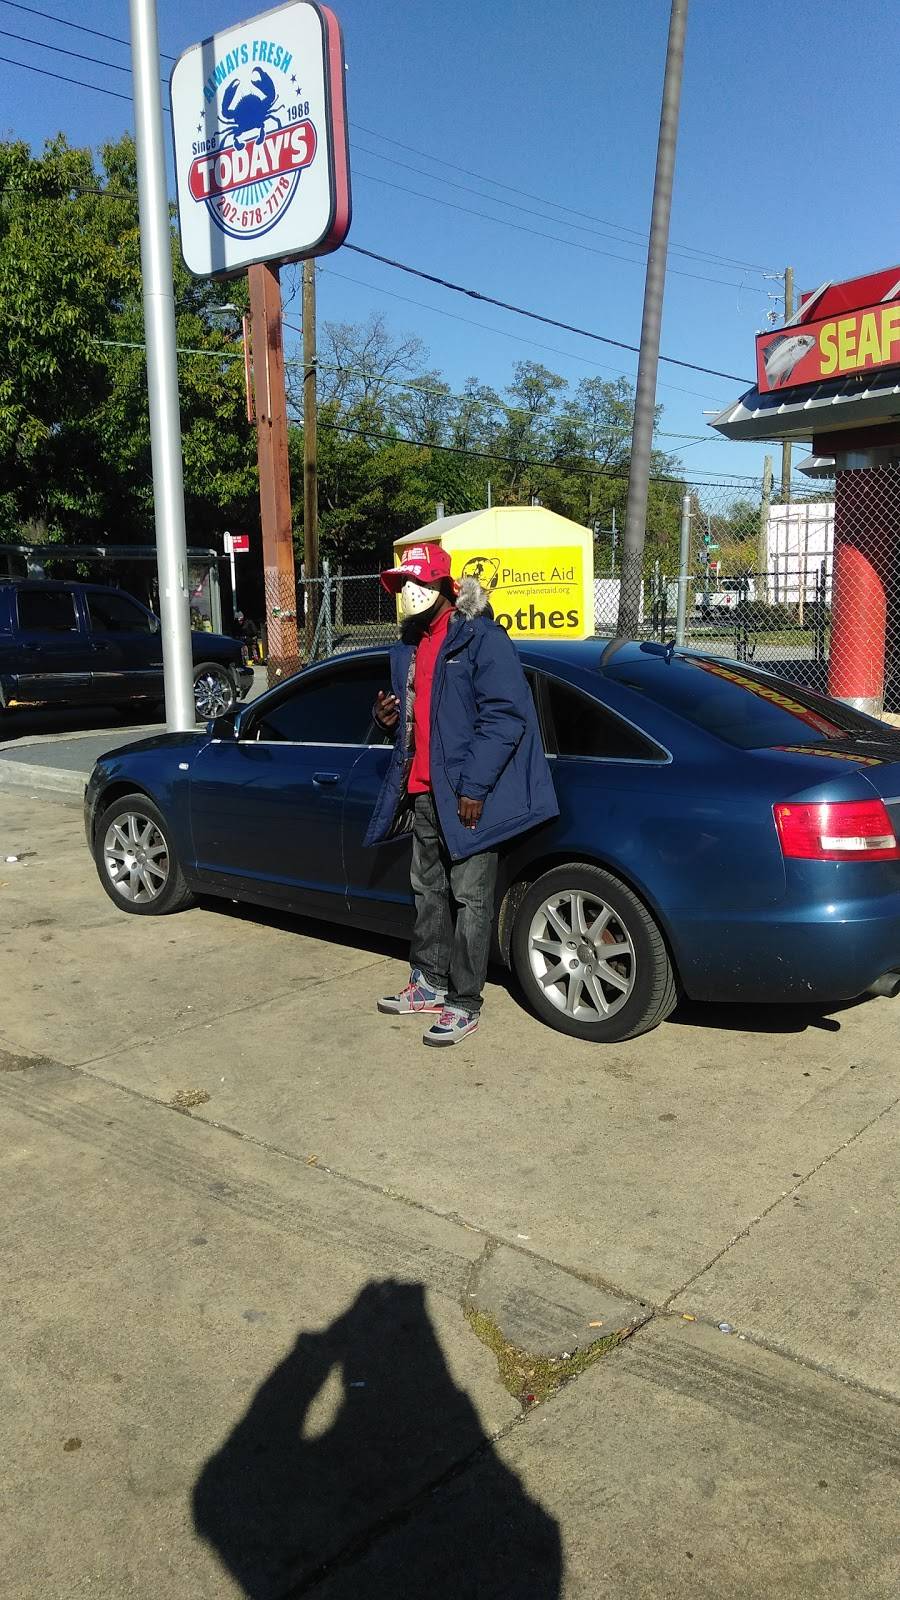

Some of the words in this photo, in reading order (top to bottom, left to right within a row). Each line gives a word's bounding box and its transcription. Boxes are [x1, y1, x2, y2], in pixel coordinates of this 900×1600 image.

[203, 43, 249, 104] ALWAYS
[252, 40, 293, 74] FRESH
[192, 137, 216, 155] Since
[287, 101, 310, 121] 1988
[197, 126, 308, 193] TODAY'S
[216, 176, 290, 227] 202-678-7778
[819, 305, 900, 375] SEAF
[502, 568, 545, 583] Planet
[551, 566, 574, 581] Aid
[506, 587, 570, 596] www.planetaid.org
